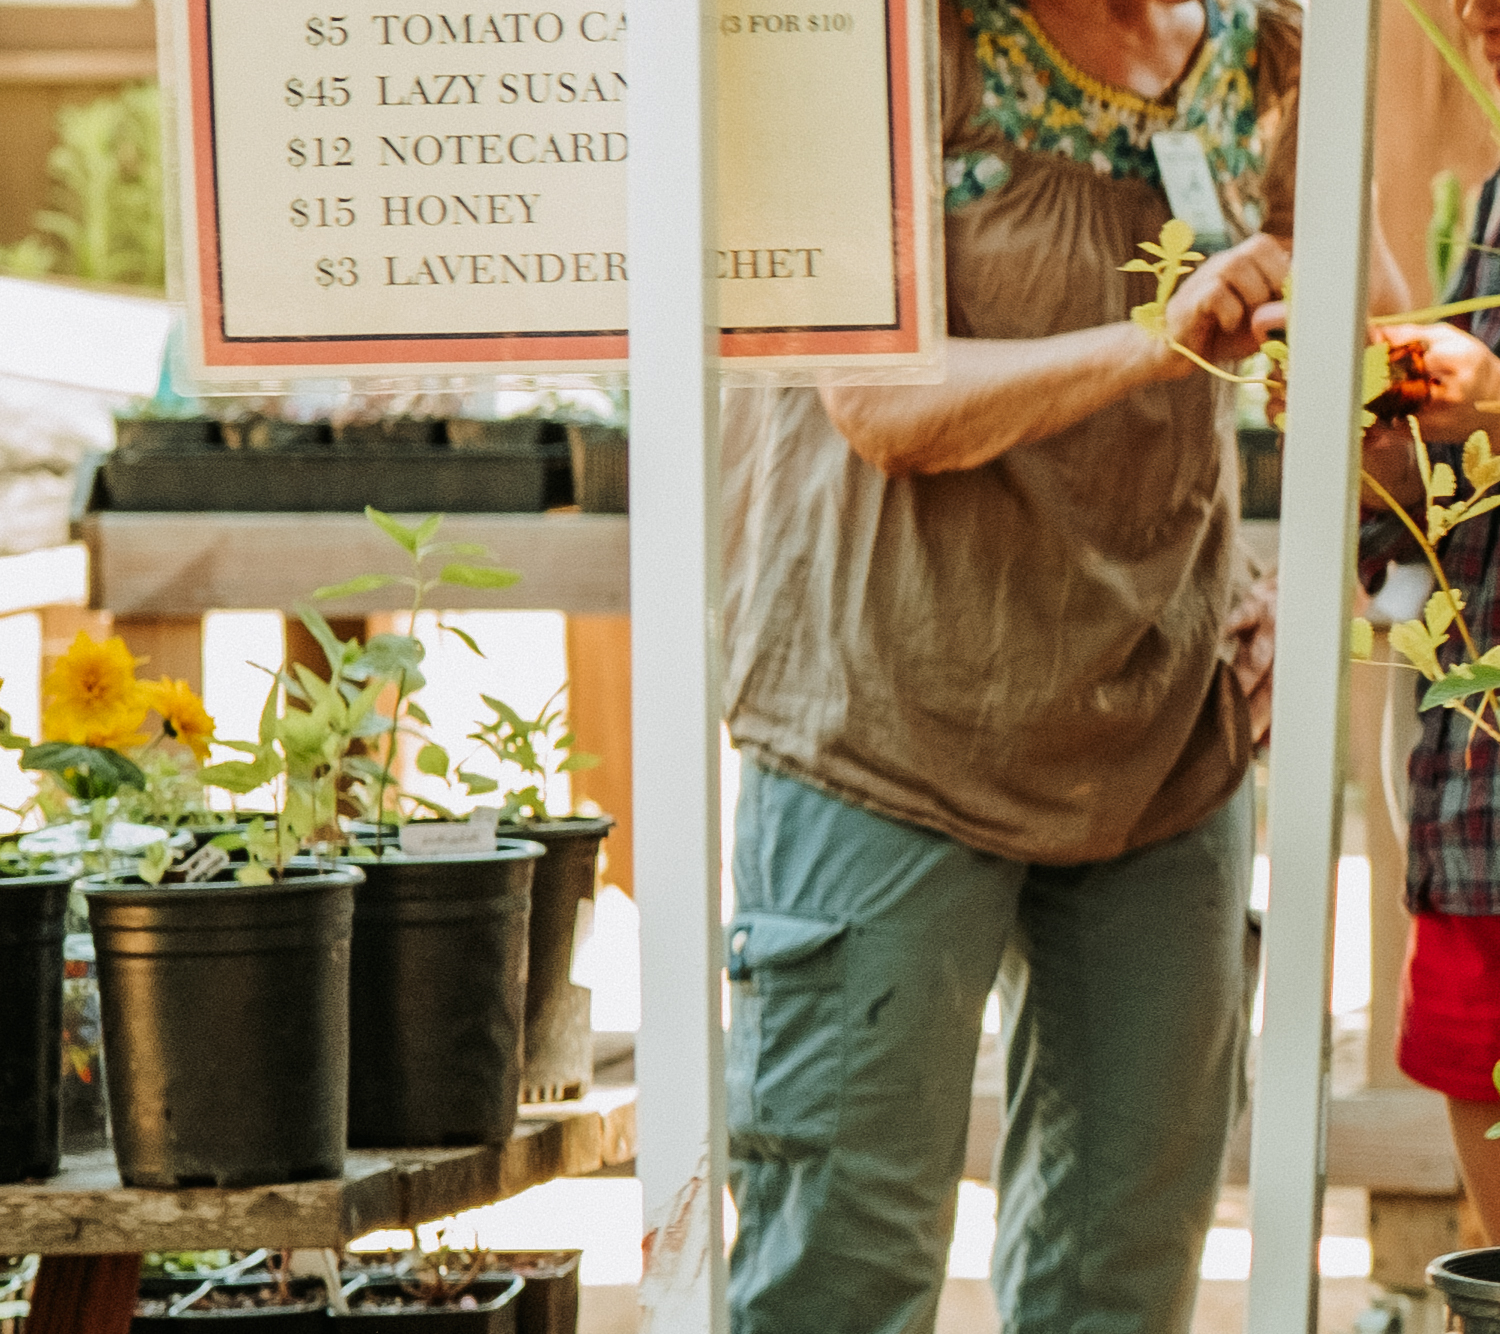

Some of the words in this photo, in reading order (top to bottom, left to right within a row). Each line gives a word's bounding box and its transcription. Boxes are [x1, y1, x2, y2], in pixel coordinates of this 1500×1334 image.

[306, 15, 350, 48] $5
[371, 11, 564, 46] TOMATO
[748, 14, 801, 34] FOR
[806, 13, 853, 33] $10)
[285, 76, 352, 110] $45
[375, 74, 486, 107] LAZY
[287, 136, 353, 169] $12
[379, 132, 629, 167] NOTECARD
[289, 196, 357, 230] $15
[380, 193, 542, 227] HONEY
[315, 255, 360, 289] $3
[384, 252, 629, 287] LAVENDER
